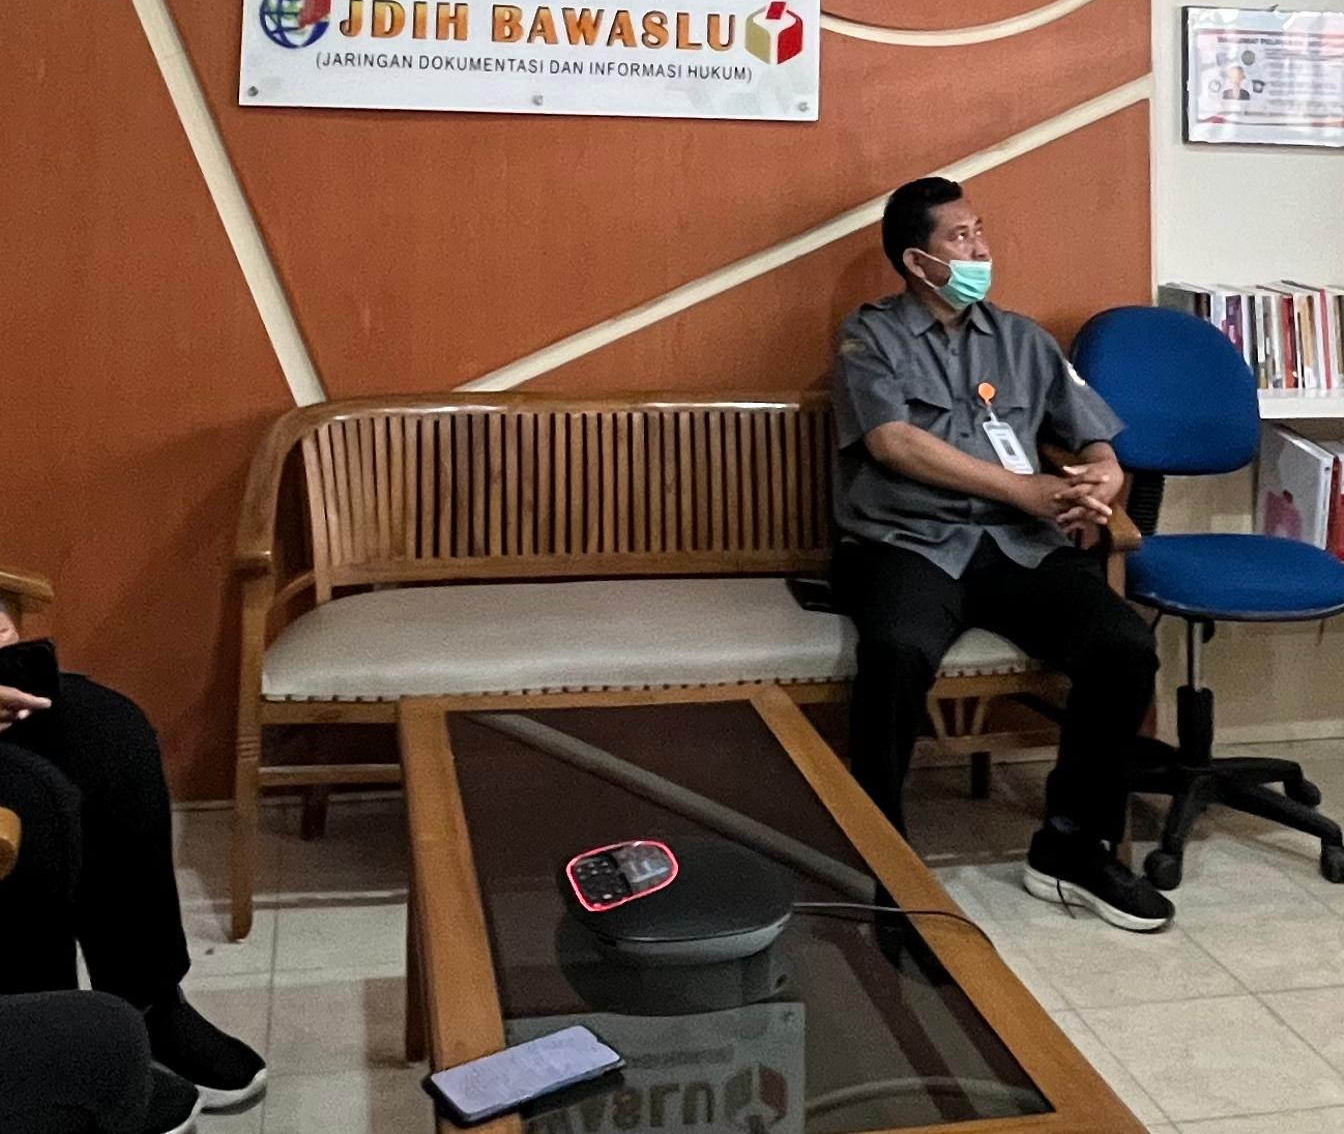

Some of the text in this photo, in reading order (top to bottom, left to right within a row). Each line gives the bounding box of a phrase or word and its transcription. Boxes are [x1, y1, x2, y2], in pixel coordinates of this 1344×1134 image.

[491, 3, 736, 52] BAWASLU
[315, 51, 753, 84] (JARINGAN DOKUMENTASI DAN INFORMASI HUKUM)
